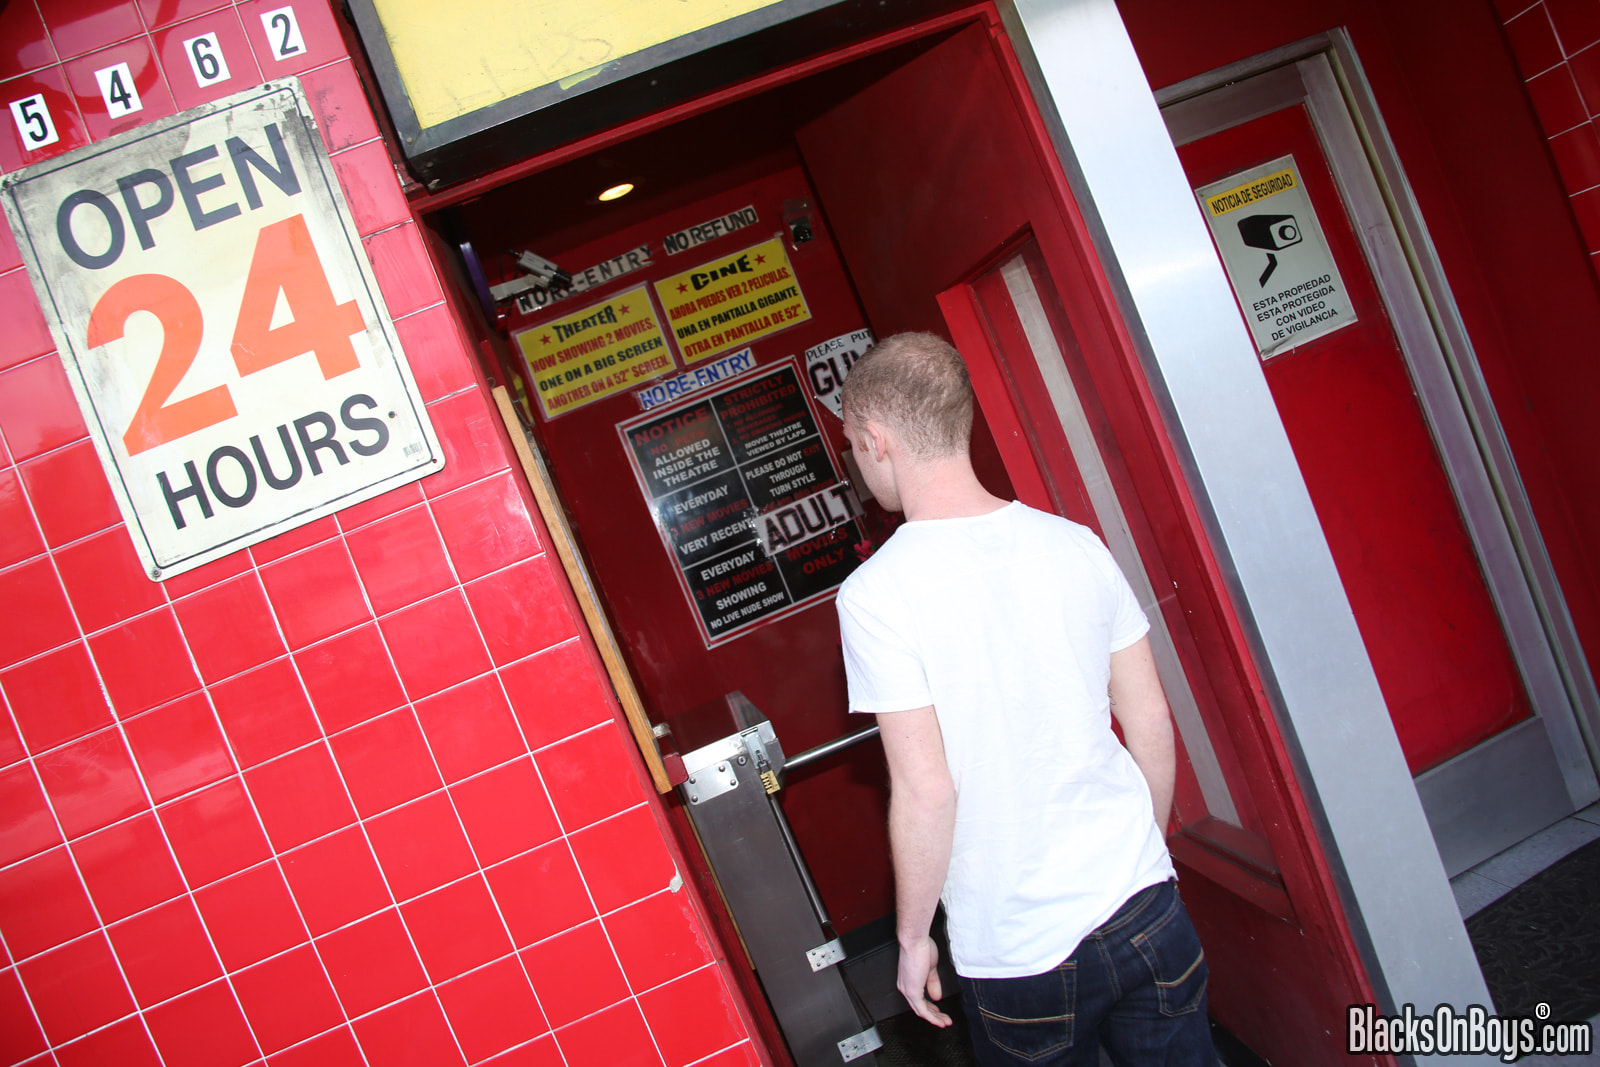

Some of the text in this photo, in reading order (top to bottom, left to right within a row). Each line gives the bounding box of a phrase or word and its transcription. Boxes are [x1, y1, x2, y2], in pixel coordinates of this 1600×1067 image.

[17, 13, 298, 142] 5 4 6 2
[56, 123, 303, 270] OPEN
[1211, 173, 1293, 214] NOTICIA DE SEGURIDAD
[664, 207, 757, 254] NO REFUND
[690, 254, 753, 291] CINE
[518, 288, 547, 312] NO
[669, 267, 791, 321] AHORA PUEDES VER 2 PELICULAS.
[1253, 274, 1331, 312] ESTA PROPIEDAD
[1257, 284, 1336, 322] ESTA PROTEGIDA
[552, 305, 617, 343] THEATER
[677, 286, 798, 339] UNA EN PANTALLA GIGANTE
[1271, 308, 1338, 341] DE VIGILANCIA
[1276, 300, 1327, 327] CON VIDEO
[87, 213, 367, 457] 24
[531, 317, 656, 373] NOW SHOWING 2 MOVIES.
[684, 338, 712, 357] OTRA
[711, 333, 725, 347] EN
[724, 315, 771, 342] PANTALLA
[772, 311, 785, 324] DE
[806, 330, 872, 361] PLEASE PUT
[539, 337, 663, 391] ONE ON A BIG SCREEN
[547, 385, 591, 410] ANOTHER
[591, 380, 605, 393] ON
[604, 376, 614, 388] A
[631, 354, 671, 377] SCREEN.
[640, 350, 752, 408] NO RE-ENTRY
[809, 344, 872, 396] GU
[721, 384, 796, 420] PROHIBITED
[723, 375, 782, 405] STRICTLY
[634, 407, 710, 446] NOTICE
[650, 428, 705, 456] NO PETS
[745, 421, 802, 449] MOVIE THEATRE
[746, 428, 806, 457] VIEWED BY LAPD
[156, 393, 390, 530] HOURS
[653, 447, 720, 479] INSIDE THE
[655, 439, 710, 466] ALLOWED
[745, 463, 774, 480] PLEASE
[775, 457, 787, 470] DO
[788, 451, 803, 464] NOT
[663, 460, 718, 487] THEATRE
[769, 463, 806, 483] THROUGH
[769, 473, 816, 497] TURN STYLE
[671, 498, 748, 537] 3 NEW MOVIES
[674, 485, 728, 515] EVERYDAY
[679, 518, 752, 555] VERY RECENT
[765, 486, 855, 553] ADULT
[786, 528, 848, 562] MOVIES
[803, 547, 844, 574] ONLY
[695, 561, 774, 600] 3 NEW MOVIES
[701, 551, 756, 581] EVERYDAY
[710, 592, 785, 630] NO LIVE NUDE SHOW
[716, 582, 767, 611] SHOWING
